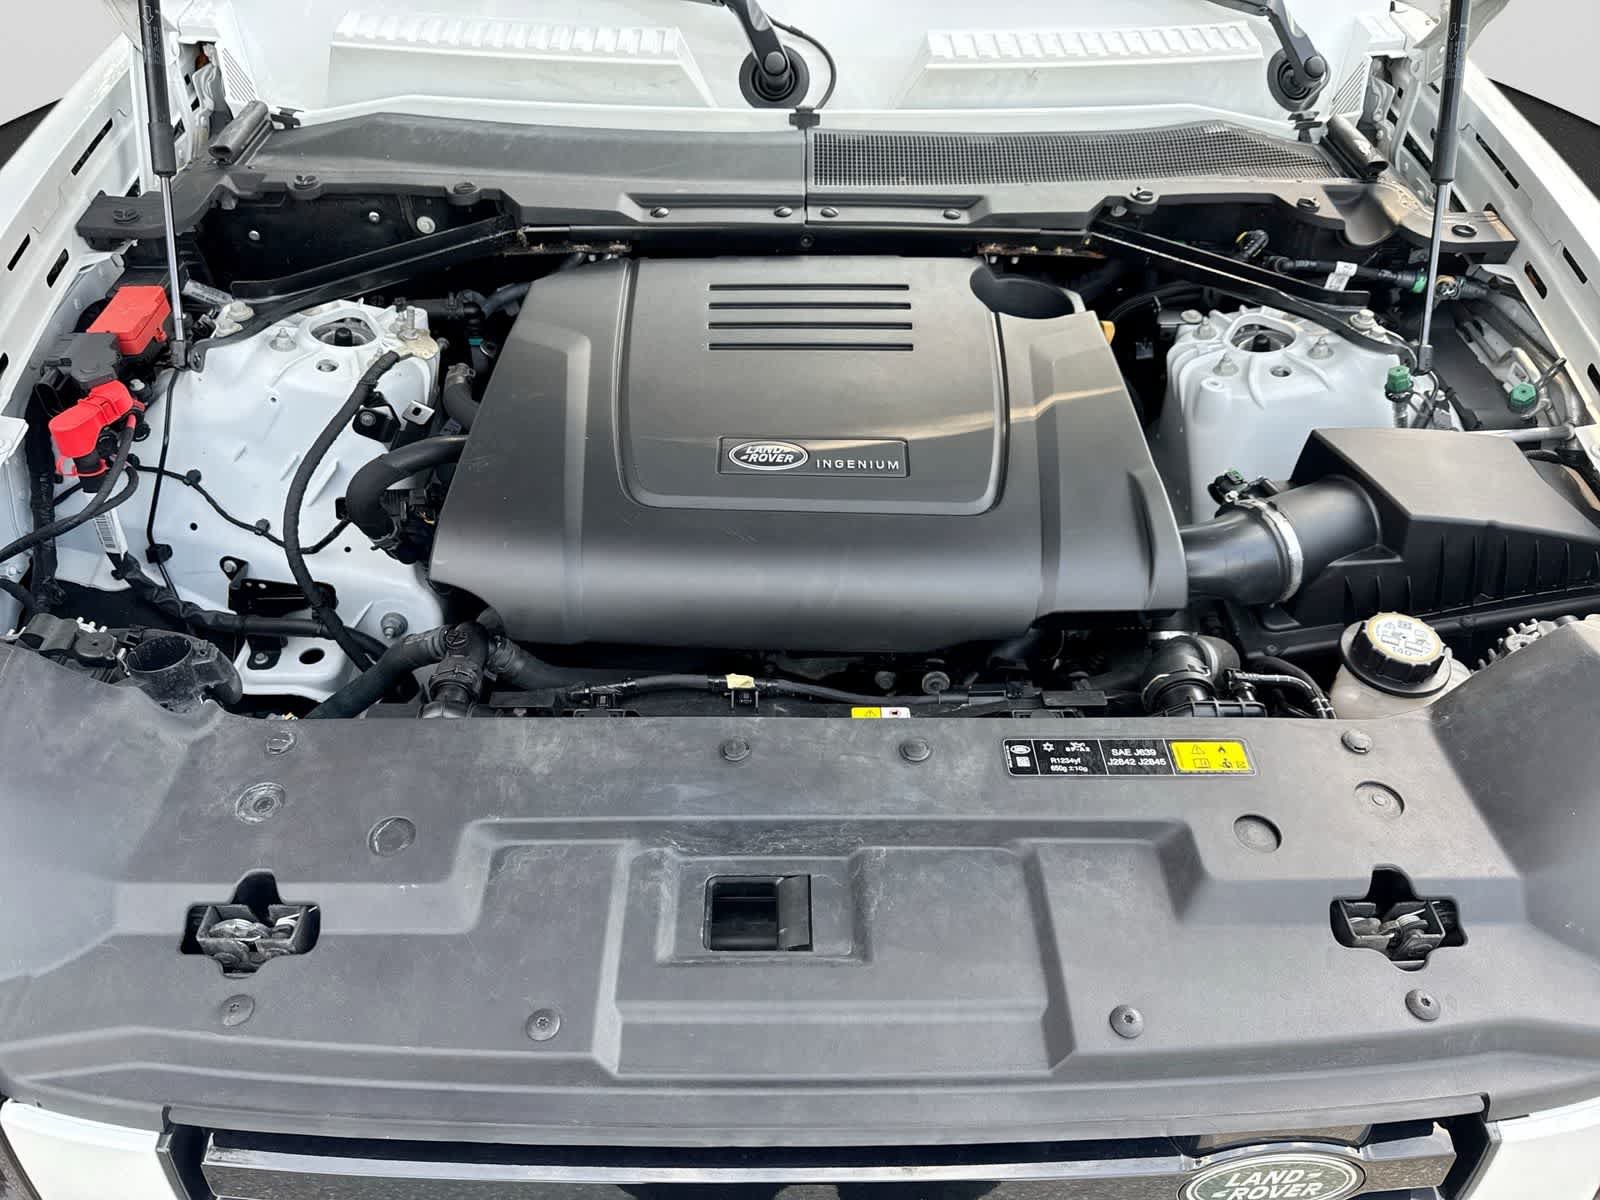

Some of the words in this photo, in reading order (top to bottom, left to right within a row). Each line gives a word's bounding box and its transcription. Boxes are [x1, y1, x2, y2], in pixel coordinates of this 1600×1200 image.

[745, 446, 784, 454] LAND
[748, 453, 794, 463] ROVER
[816, 459, 899, 470] INGENIUM
[1111, 748, 1132, 756] SAE
[1134, 748, 1157, 756] J639
[1107, 758, 1136, 766] J2842
[1225, 1169, 1305, 1188] LAND
[1226, 1182, 1323, 1200] ROVER
